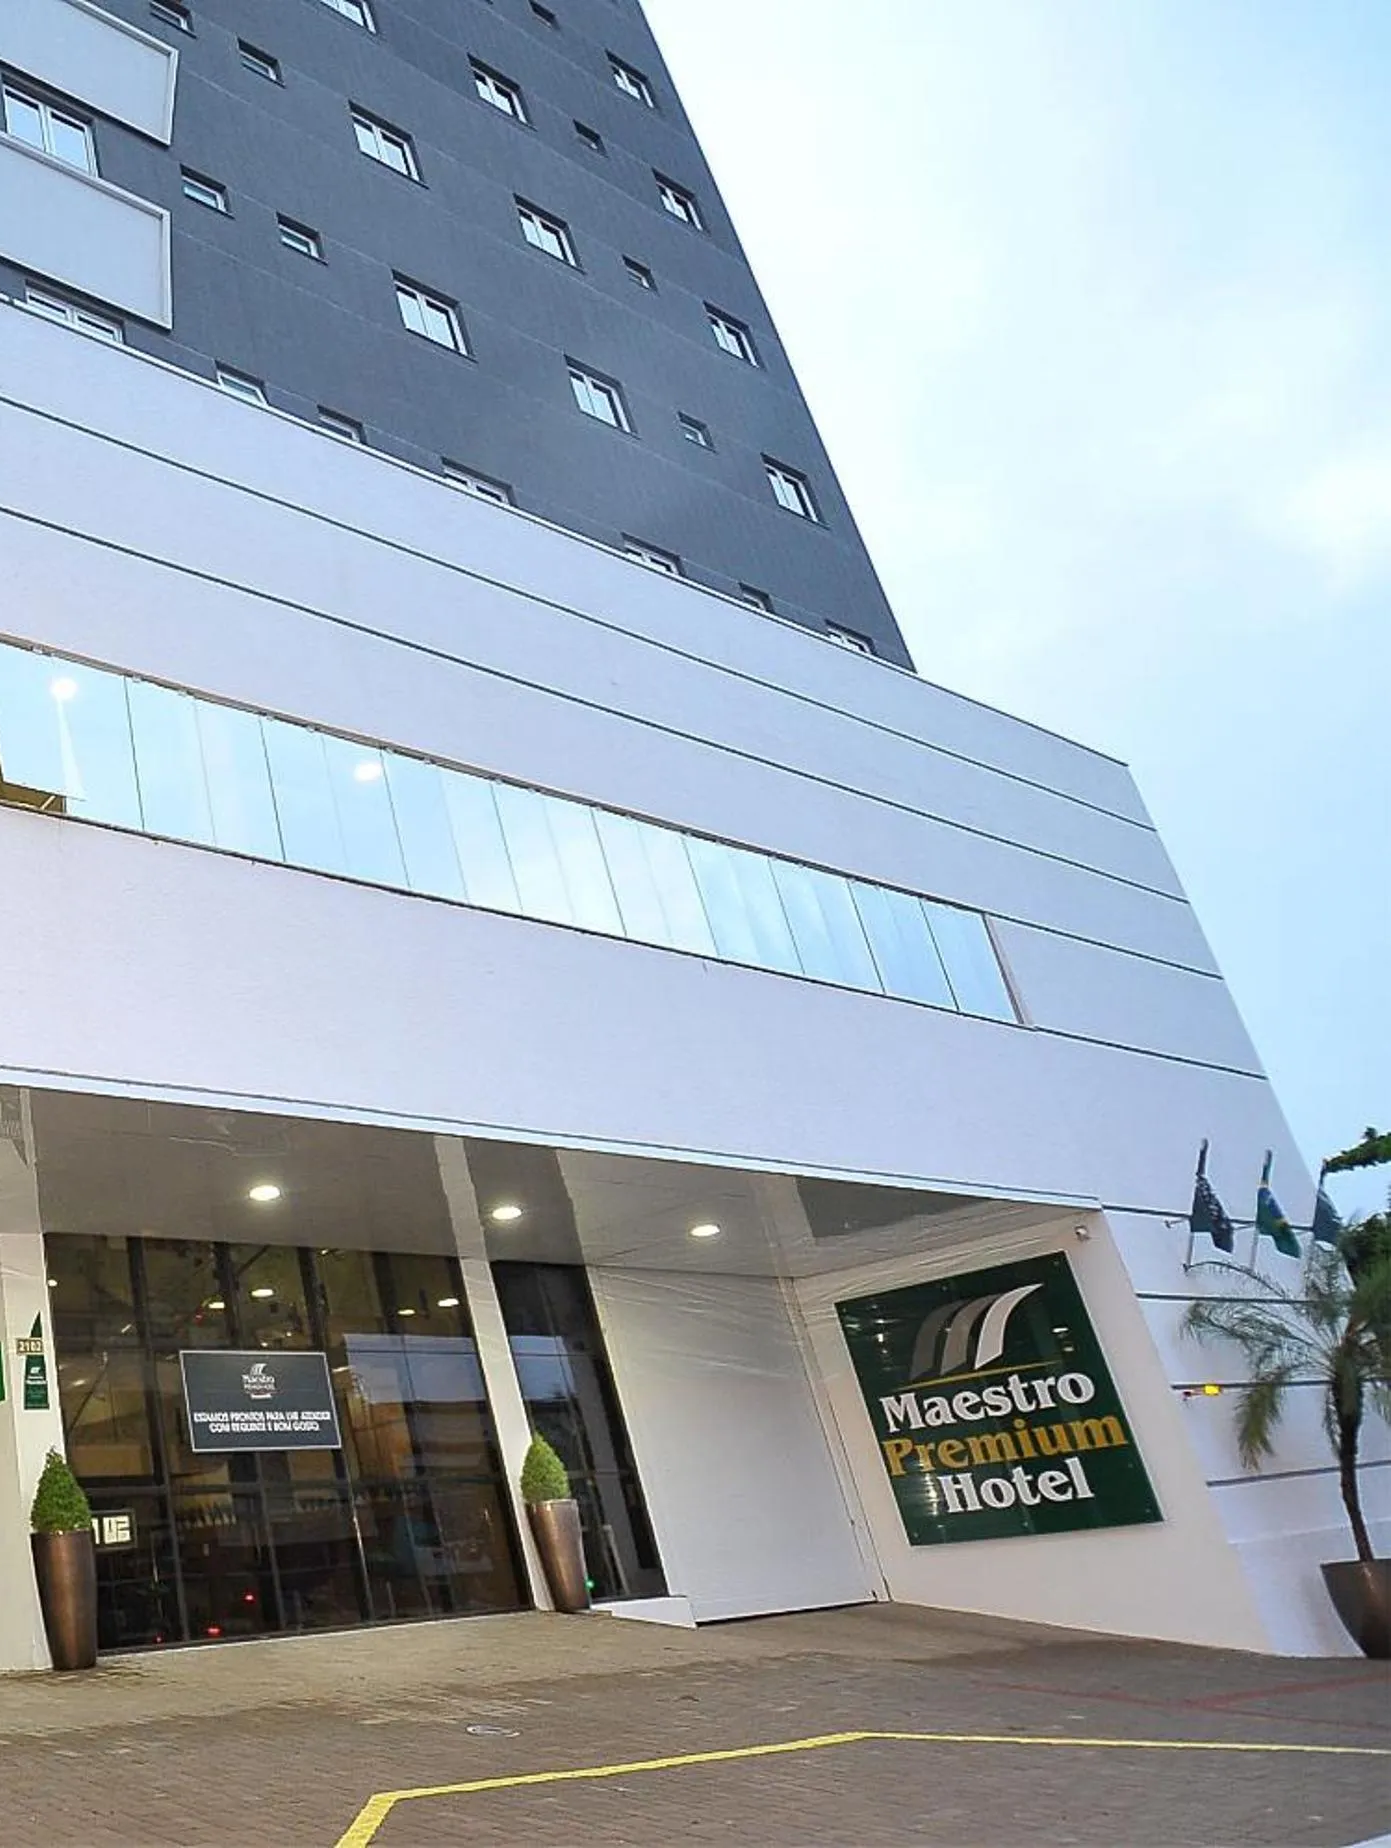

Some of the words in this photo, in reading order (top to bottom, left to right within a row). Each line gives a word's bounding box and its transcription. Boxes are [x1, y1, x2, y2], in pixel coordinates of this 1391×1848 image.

[879, 1372, 1095, 1433] Maestro
[882, 1415, 1128, 1476] Premium
[937, 1457, 1095, 1513] Hotel
